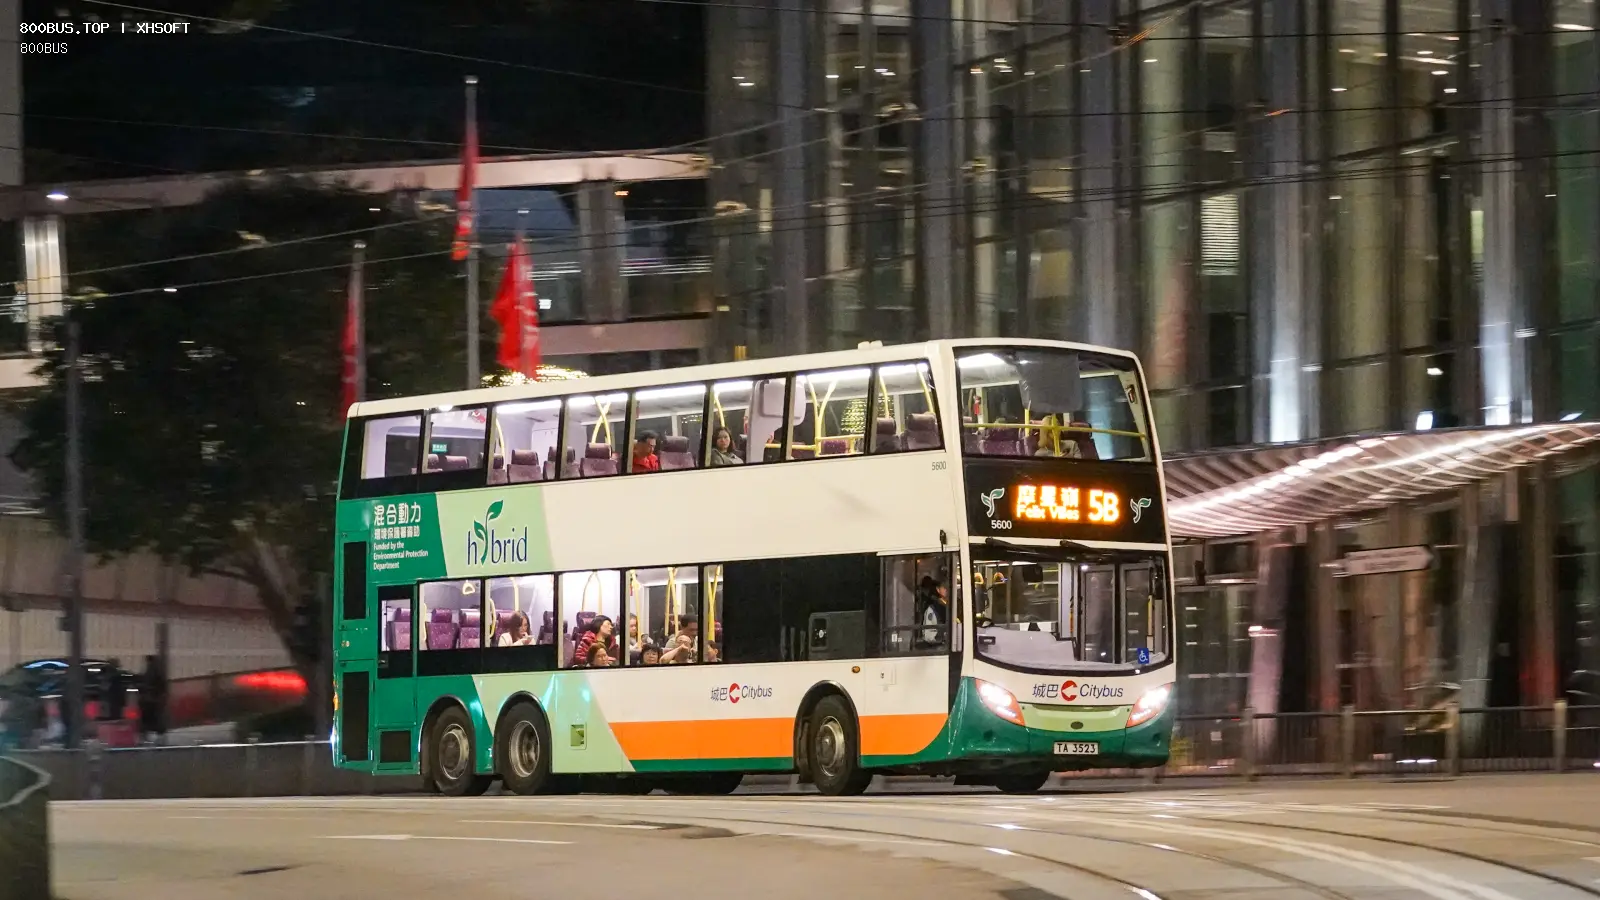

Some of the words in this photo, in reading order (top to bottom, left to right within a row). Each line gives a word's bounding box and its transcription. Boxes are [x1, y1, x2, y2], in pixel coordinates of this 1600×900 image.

[931, 461, 947, 471] 5600
[1088, 489, 1120, 521] 5B
[374, 502, 422, 526] 混合動力
[990, 520, 1013, 530] 5600
[373, 542, 390, 551] Funded
[390, 541, 398, 551] by
[397, 540, 405, 550] the
[373, 550, 405, 561] Environmental
[405, 548, 429, 558] Protection
[373, 561, 400, 572] Department
[710, 687, 728, 701] 城巴
[741, 685, 773, 700] Citybus
[1032, 683, 1059, 699] 城巴
[1080, 683, 1124, 699] Citybus
[1056, 743, 1069, 753] TA
[1072, 743, 1096, 753] 3523
